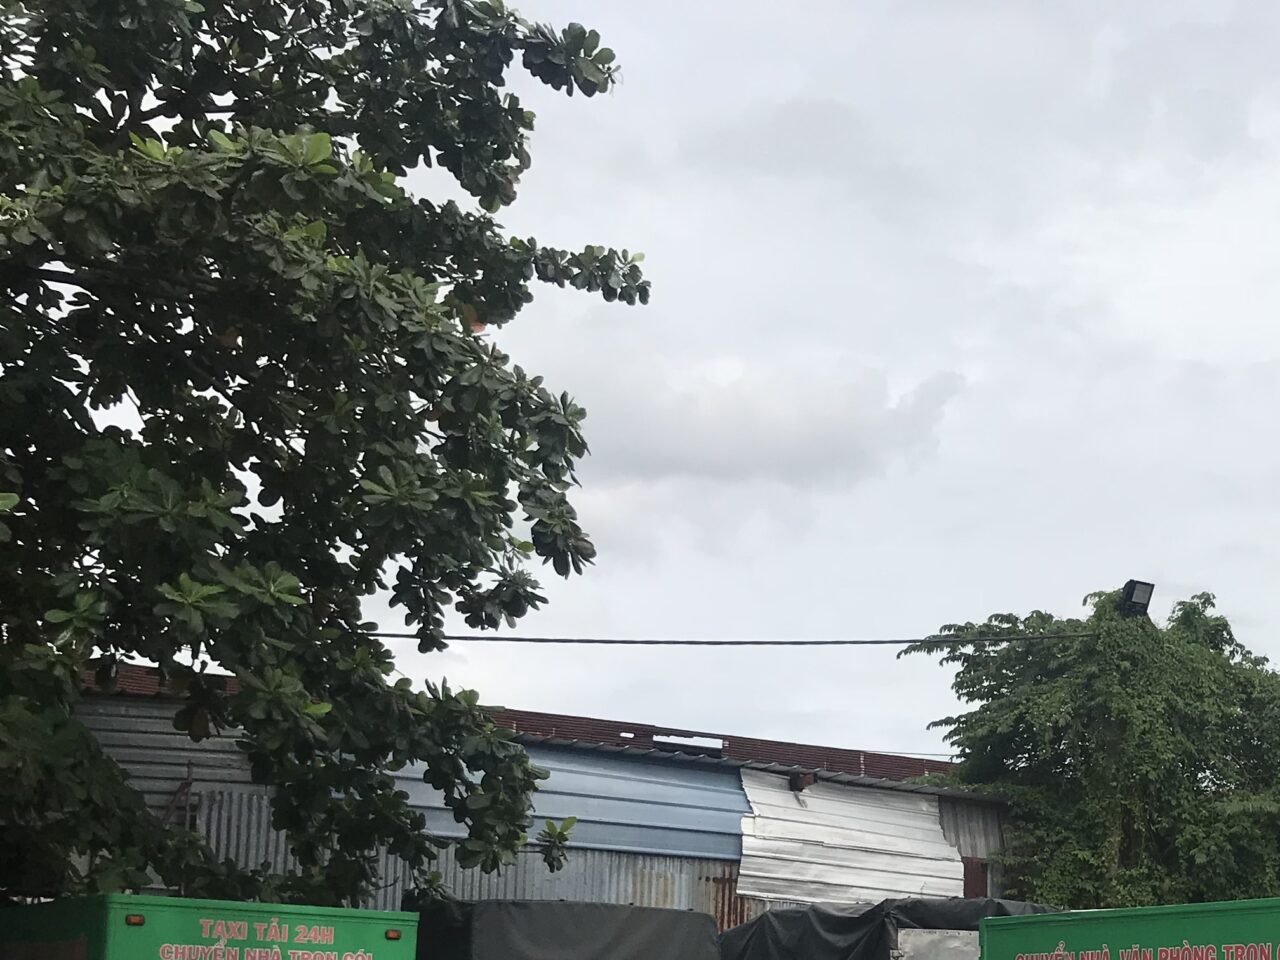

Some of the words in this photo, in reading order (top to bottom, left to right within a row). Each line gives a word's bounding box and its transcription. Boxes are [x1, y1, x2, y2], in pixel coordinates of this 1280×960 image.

[200, 919, 248, 940] TAXI
[254, 917, 289, 942] TẢI
[295, 925, 334, 944] 24H
